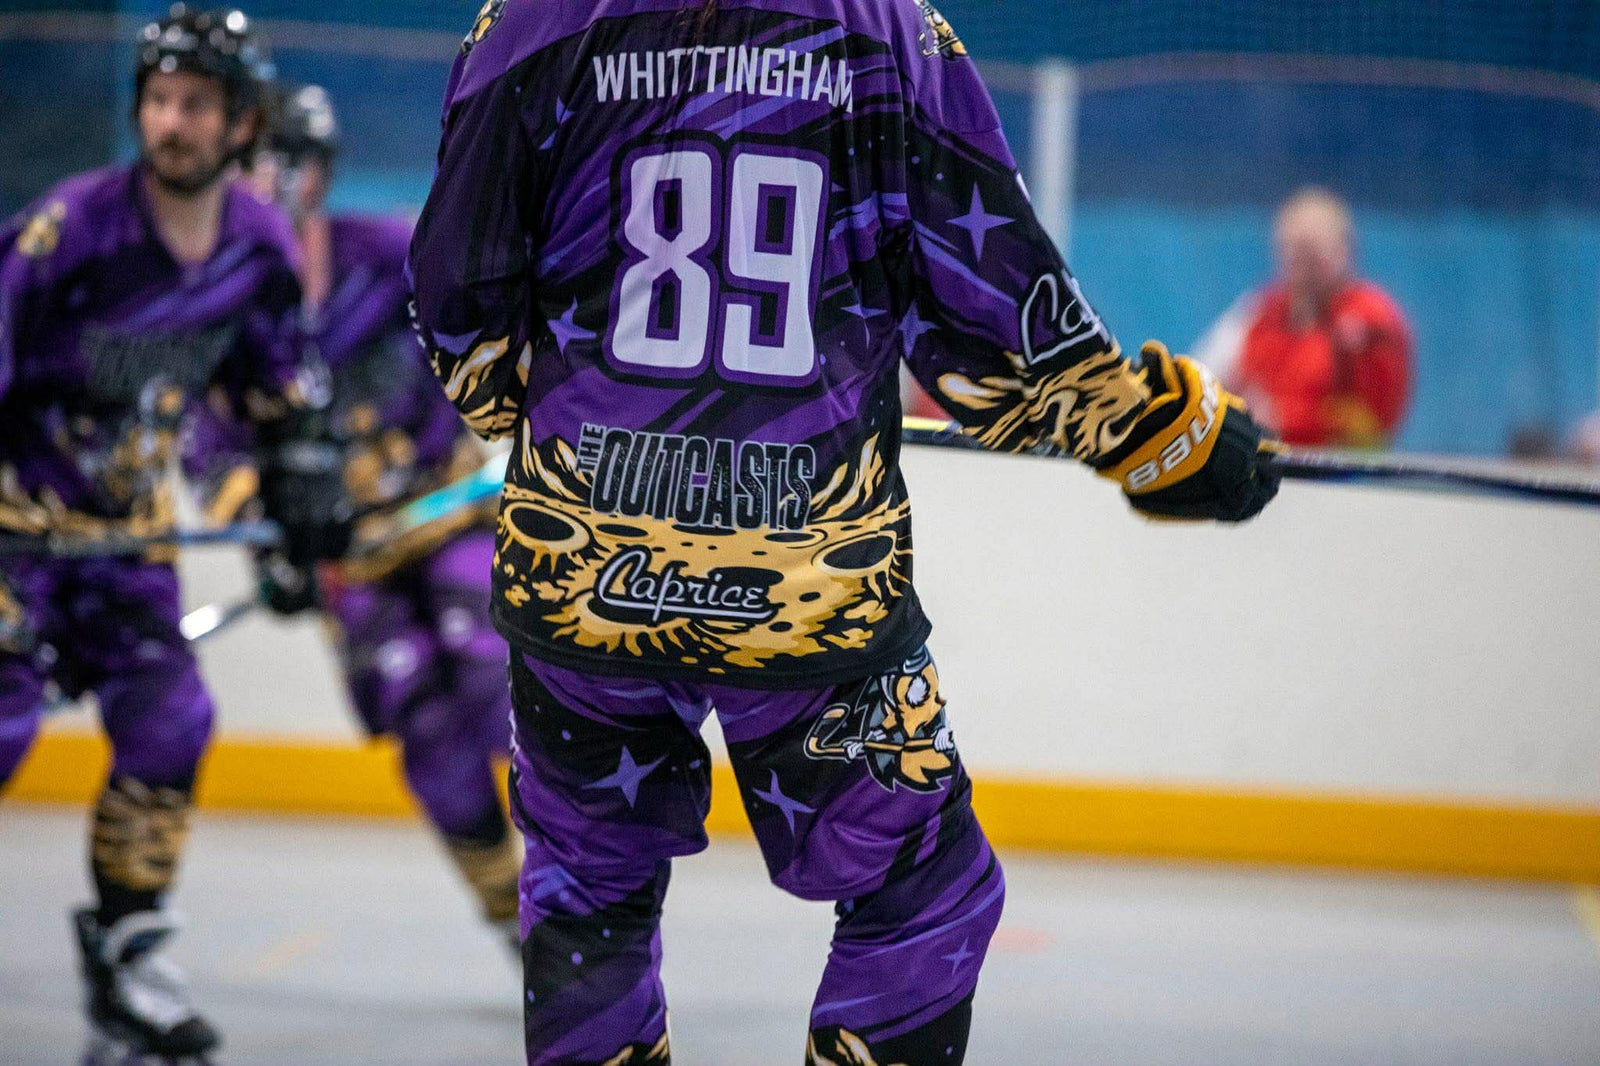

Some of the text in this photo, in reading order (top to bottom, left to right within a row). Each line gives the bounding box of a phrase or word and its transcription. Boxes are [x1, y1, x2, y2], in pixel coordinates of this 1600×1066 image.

[611, 150, 825, 377] 89
[575, 422, 816, 531] THE OUTCASTS
[598, 550, 776, 622] Caprice
